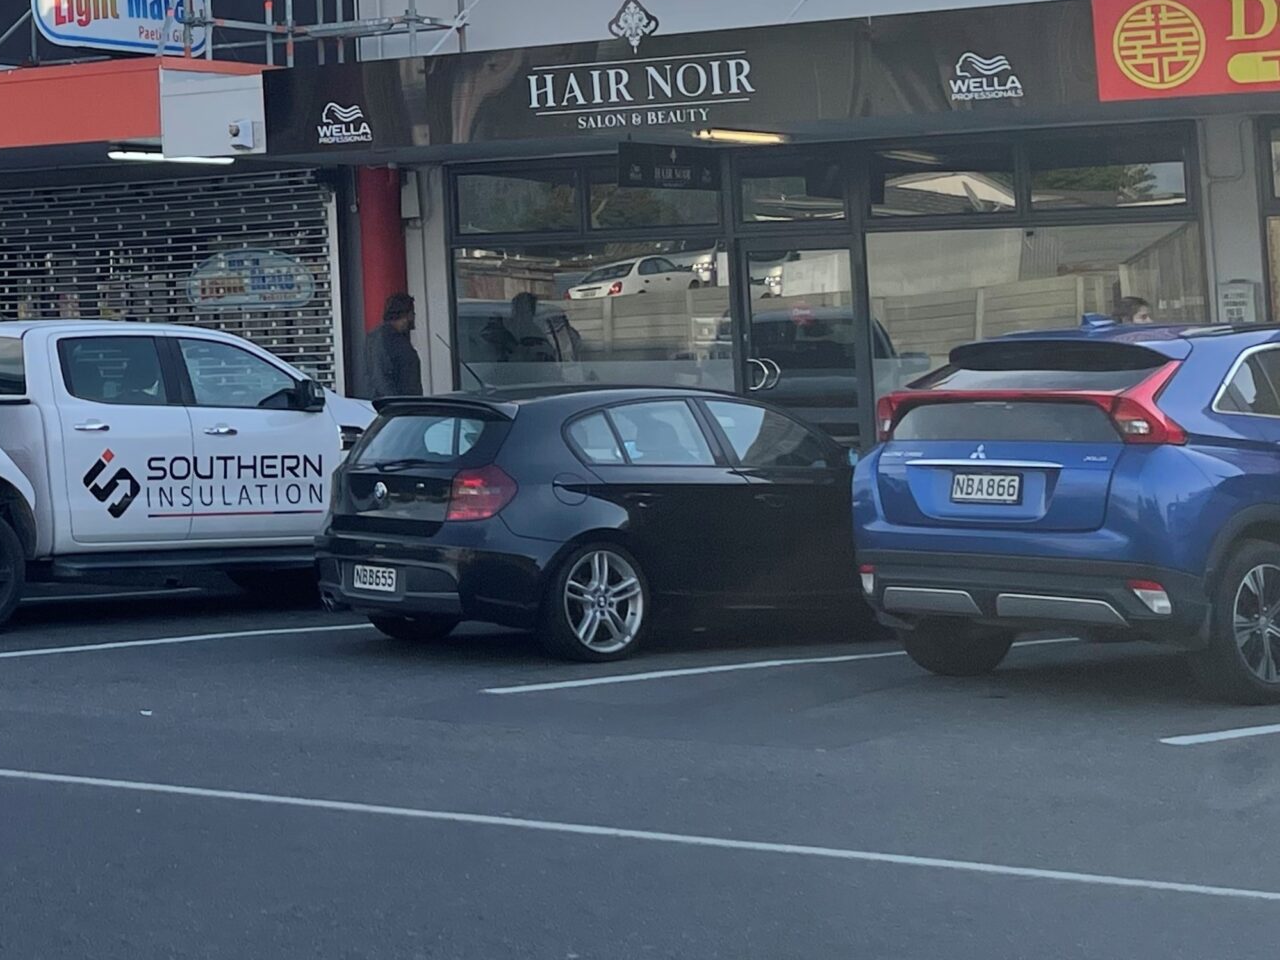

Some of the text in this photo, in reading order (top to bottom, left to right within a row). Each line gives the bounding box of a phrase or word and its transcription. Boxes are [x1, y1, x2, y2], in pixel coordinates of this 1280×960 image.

[527, 58, 756, 109] HAIR NOIR
[949, 75, 1022, 93] WELLA
[951, 87, 1024, 101] PROFESSIONALS
[578, 107, 710, 130] SALON & BEAUTY
[317, 122, 371, 138] WELLA
[147, 454, 322, 481] SOUTHERN
[146, 483, 323, 508] INSULATION
[955, 477, 1017, 498] NBA866
[354, 567, 394, 588] NBB655
